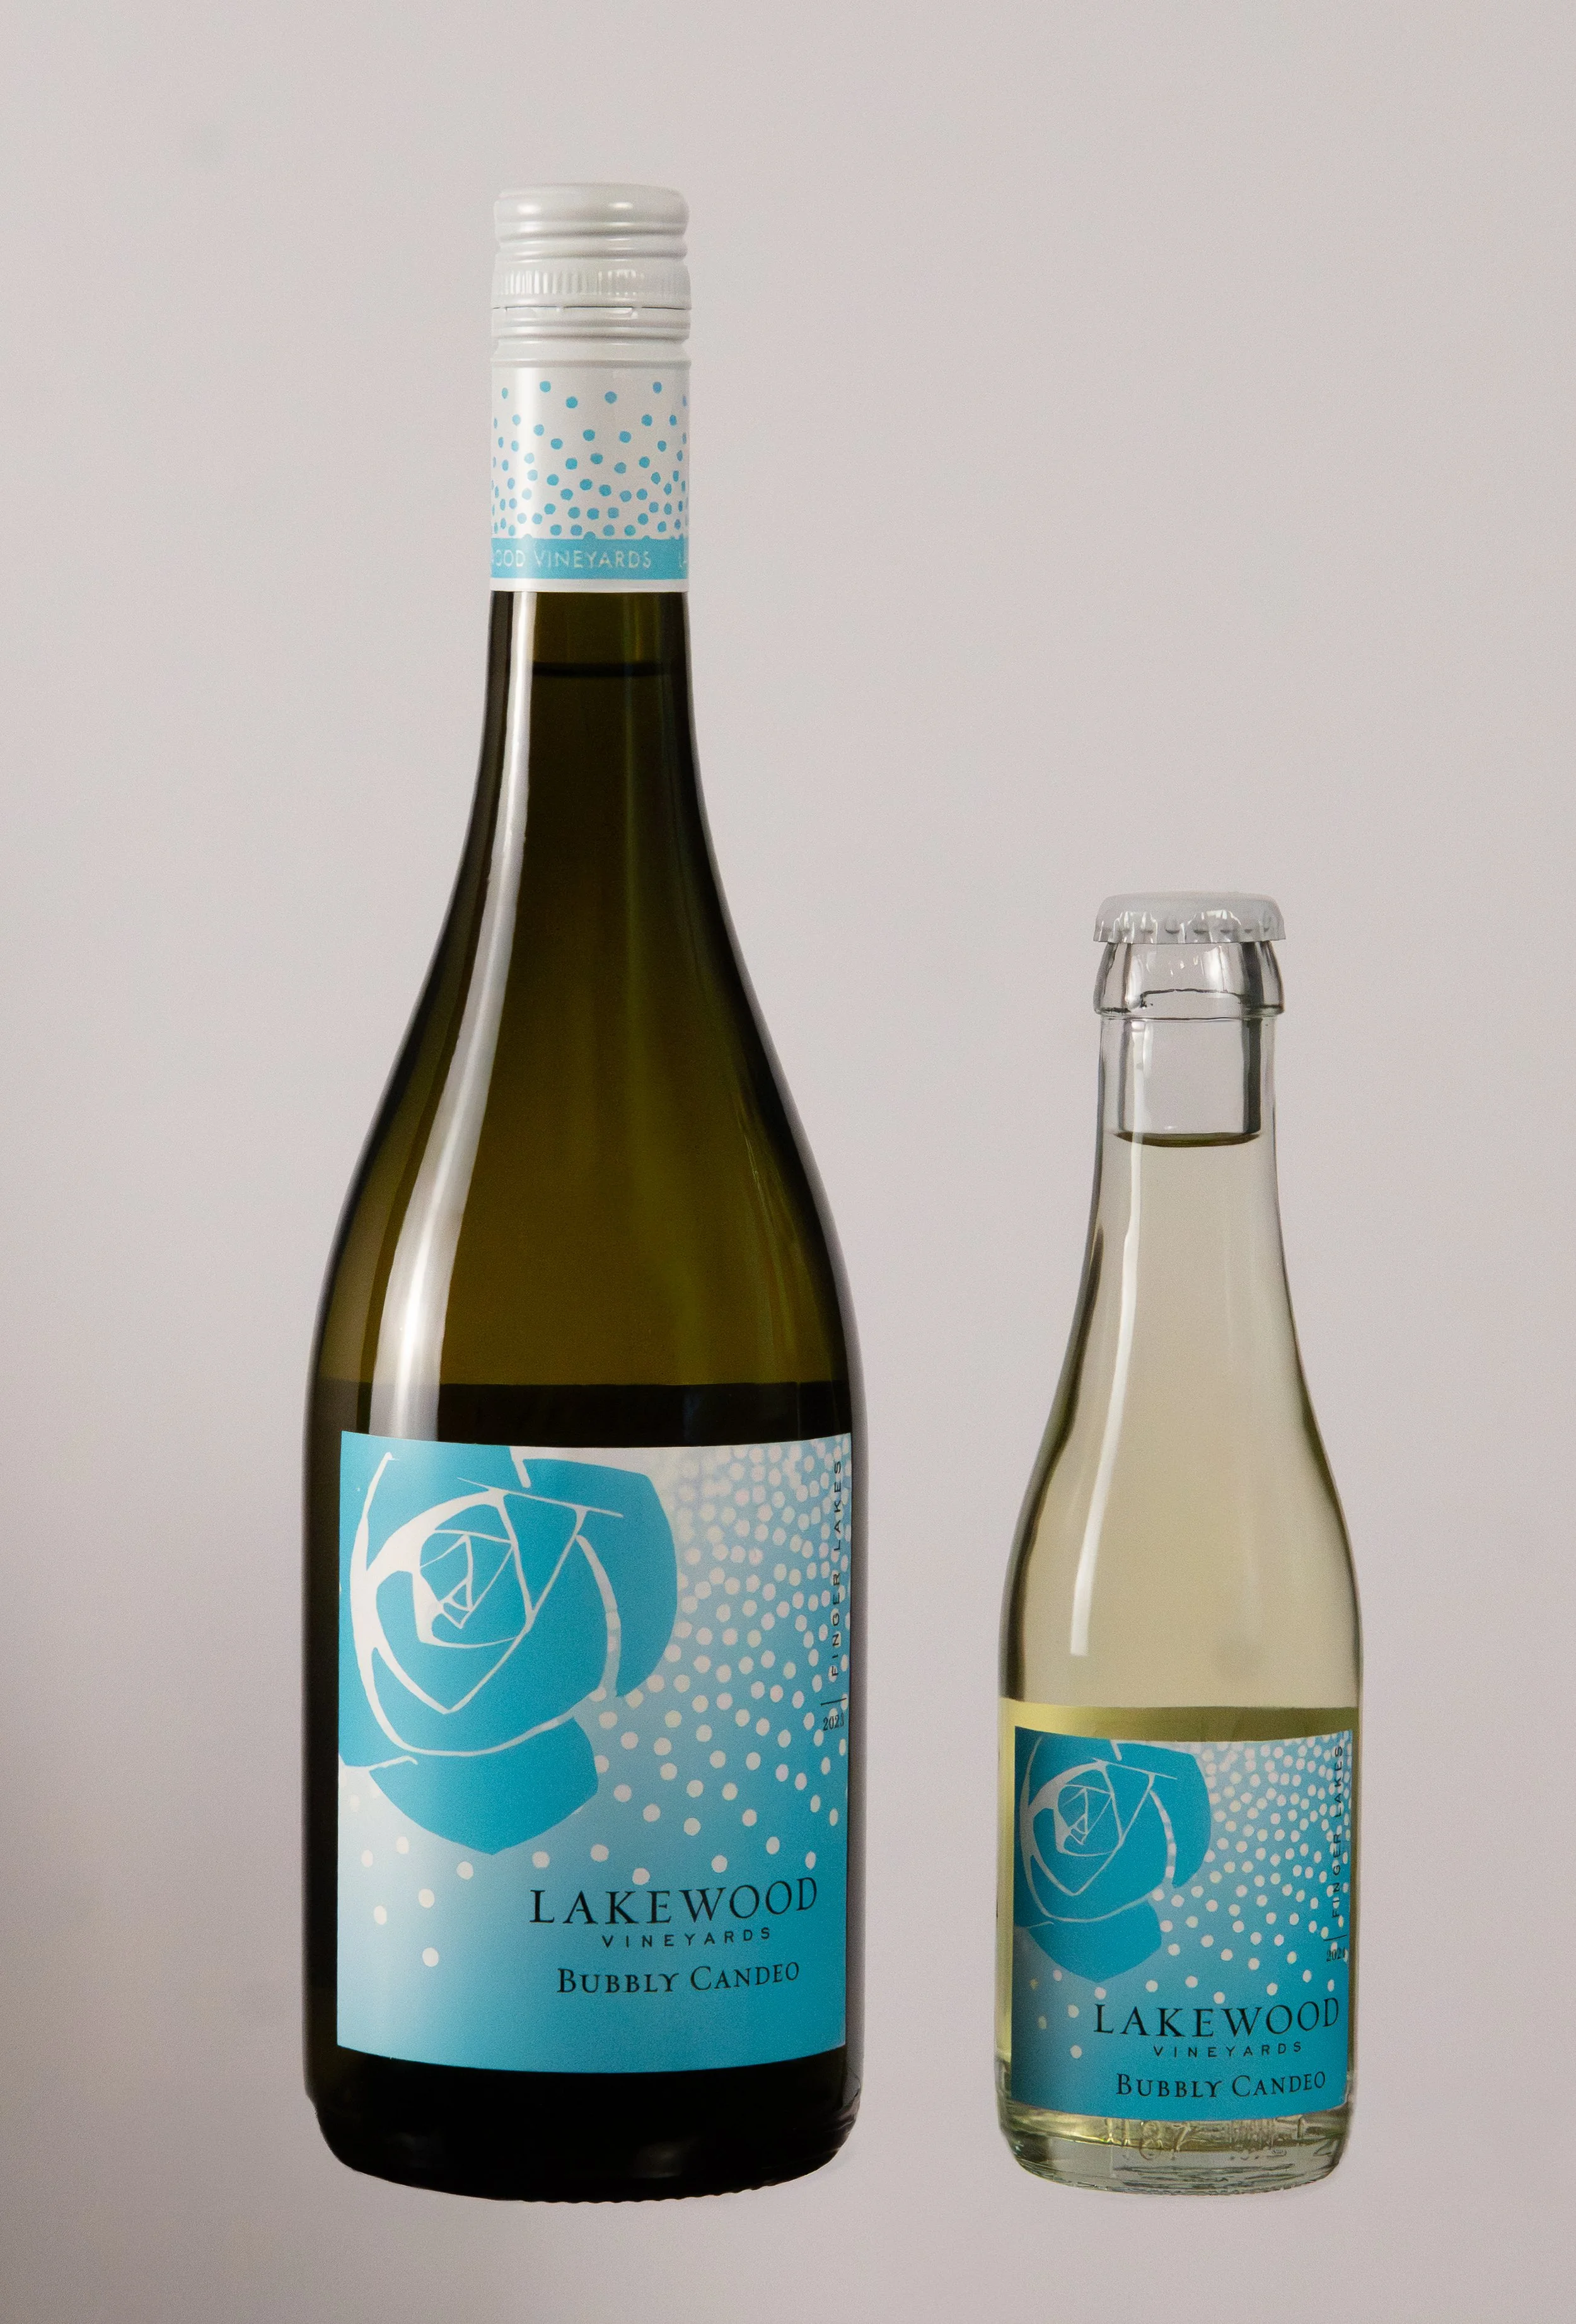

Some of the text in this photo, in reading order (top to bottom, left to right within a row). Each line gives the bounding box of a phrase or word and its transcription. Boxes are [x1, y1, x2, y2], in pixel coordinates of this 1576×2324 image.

[534, 549, 651, 569] VINEYARDS
[833, 1460, 842, 1552] LAKES
[830, 1572, 840, 1677] FINGER
[1333, 1745, 1343, 1818] LAKES
[1331, 1833, 1341, 1919] FINGER
[529, 1876, 818, 1925] LAKEWOOD
[601, 1927, 770, 1948] VINEYARDS
[557, 1961, 799, 1994] BUBBLY CANDEO
[1093, 1997, 1340, 2038] LAKEWOOD
[1153, 2041, 1302, 2058] VINEYARDS
[1116, 2071, 1326, 2098] BUBBLY CANDEO
